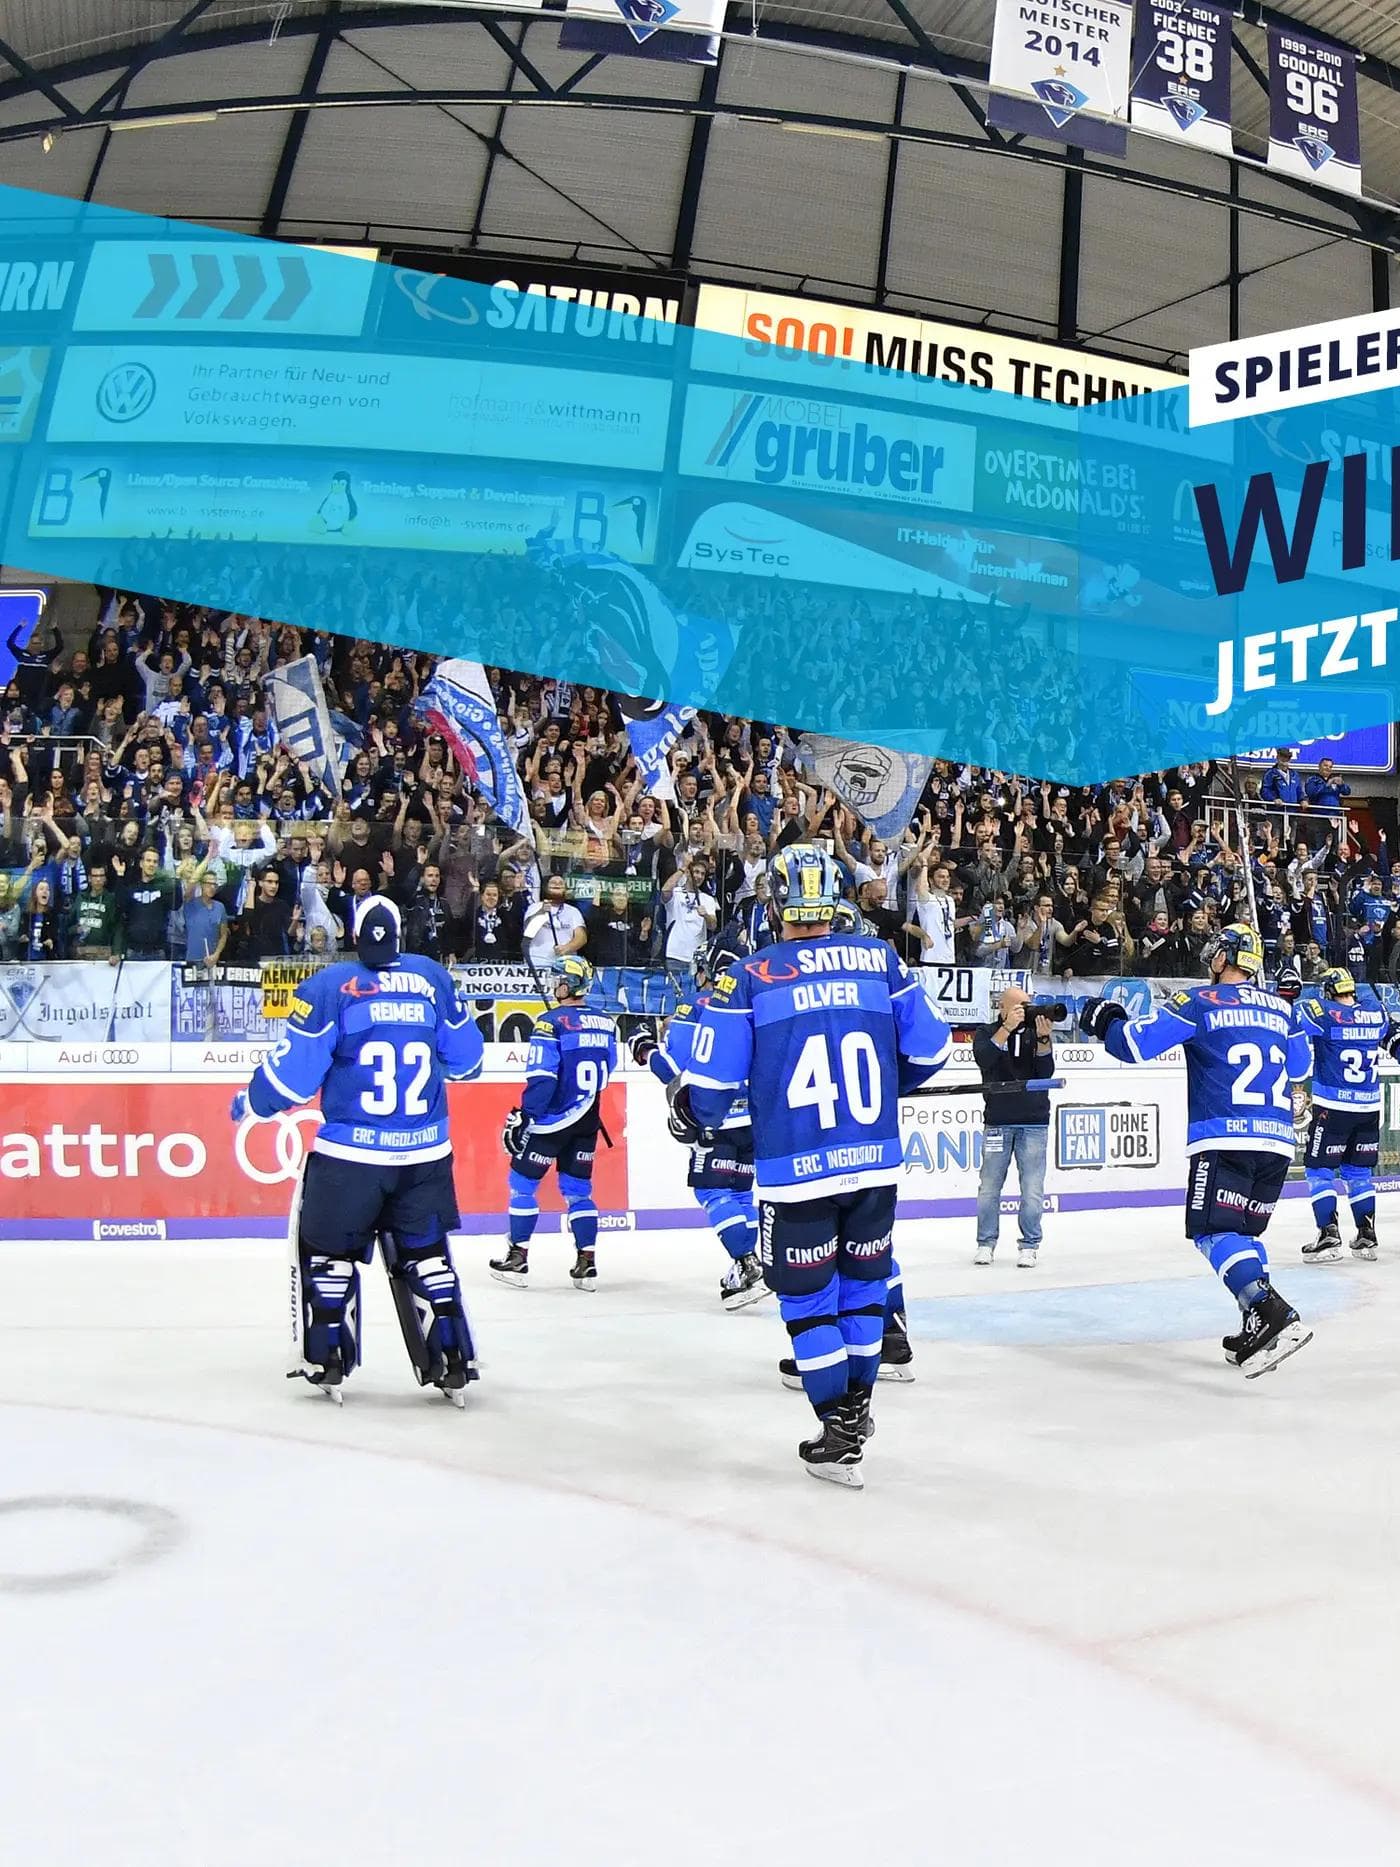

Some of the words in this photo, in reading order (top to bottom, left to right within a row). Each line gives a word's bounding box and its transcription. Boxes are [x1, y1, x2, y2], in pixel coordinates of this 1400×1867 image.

[1019, 7, 1110, 42] MEISTER
[1153, 12, 1217, 43] FICENEC
[1024, 30, 1101, 67] 2014
[1156, 31, 1213, 82] 38
[1278, 53, 1345, 88] GOODALL
[1167, 82, 1200, 97] ERC
[1286, 72, 1339, 123] 96
[1298, 122, 1328, 138] ERC
[486, 279, 678, 346] SATURN
[219, 364, 279, 381] Partner
[284, 366, 307, 383] für
[312, 368, 353, 384] Neu-
[357, 371, 391, 386] und
[744, 312, 854, 370] SOO!
[864, 332, 993, 394] MUSS
[1008, 357, 1192, 436] TECHNIK.
[188, 386, 342, 409] Gebrauchtwagen
[347, 395, 380, 410] von
[183, 410, 297, 430] Volkswagen.
[754, 420, 944, 494] gruber
[199, 474, 240, 488] Source
[416, 483, 466, 501] Support
[483, 486, 566, 507] Development
[695, 542, 791, 567] SysTec
[796, 945, 888, 975] SATURN
[263, 984, 289, 1007] FÜR
[792, 981, 860, 1012] OLVER
[937, 967, 973, 1003] 20
[37, 998, 153, 1026] Ingolstadt
[369, 1001, 426, 1024] REIMER
[579, 1033, 610, 1048] BRAUN
[57, 1050, 98, 1065] Audi
[203, 1050, 245, 1065] Audi
[357, 1040, 434, 1117] 32
[576, 1059, 609, 1103] 91
[786, 1030, 882, 1130] 40
[1227, 1042, 1293, 1112] 22
[352, 1127, 376, 1146] ERC
[379, 1125, 440, 1147] INGOLSTADT
[1065, 1112, 1101, 1135] KEIN
[1110, 1112, 1149, 1134] OHNE
[1226, 1119, 1248, 1134] ERC
[1065, 1136, 1100, 1161] FAN
[1110, 1134, 1153, 1159] JOB.
[793, 1154, 823, 1177] ERC
[1191, 1159, 1210, 1212] SATURN
[99, 1222, 159, 1237] covestro
[762, 1202, 776, 1267] SATURN
[785, 1235, 839, 1265] CINQUE
